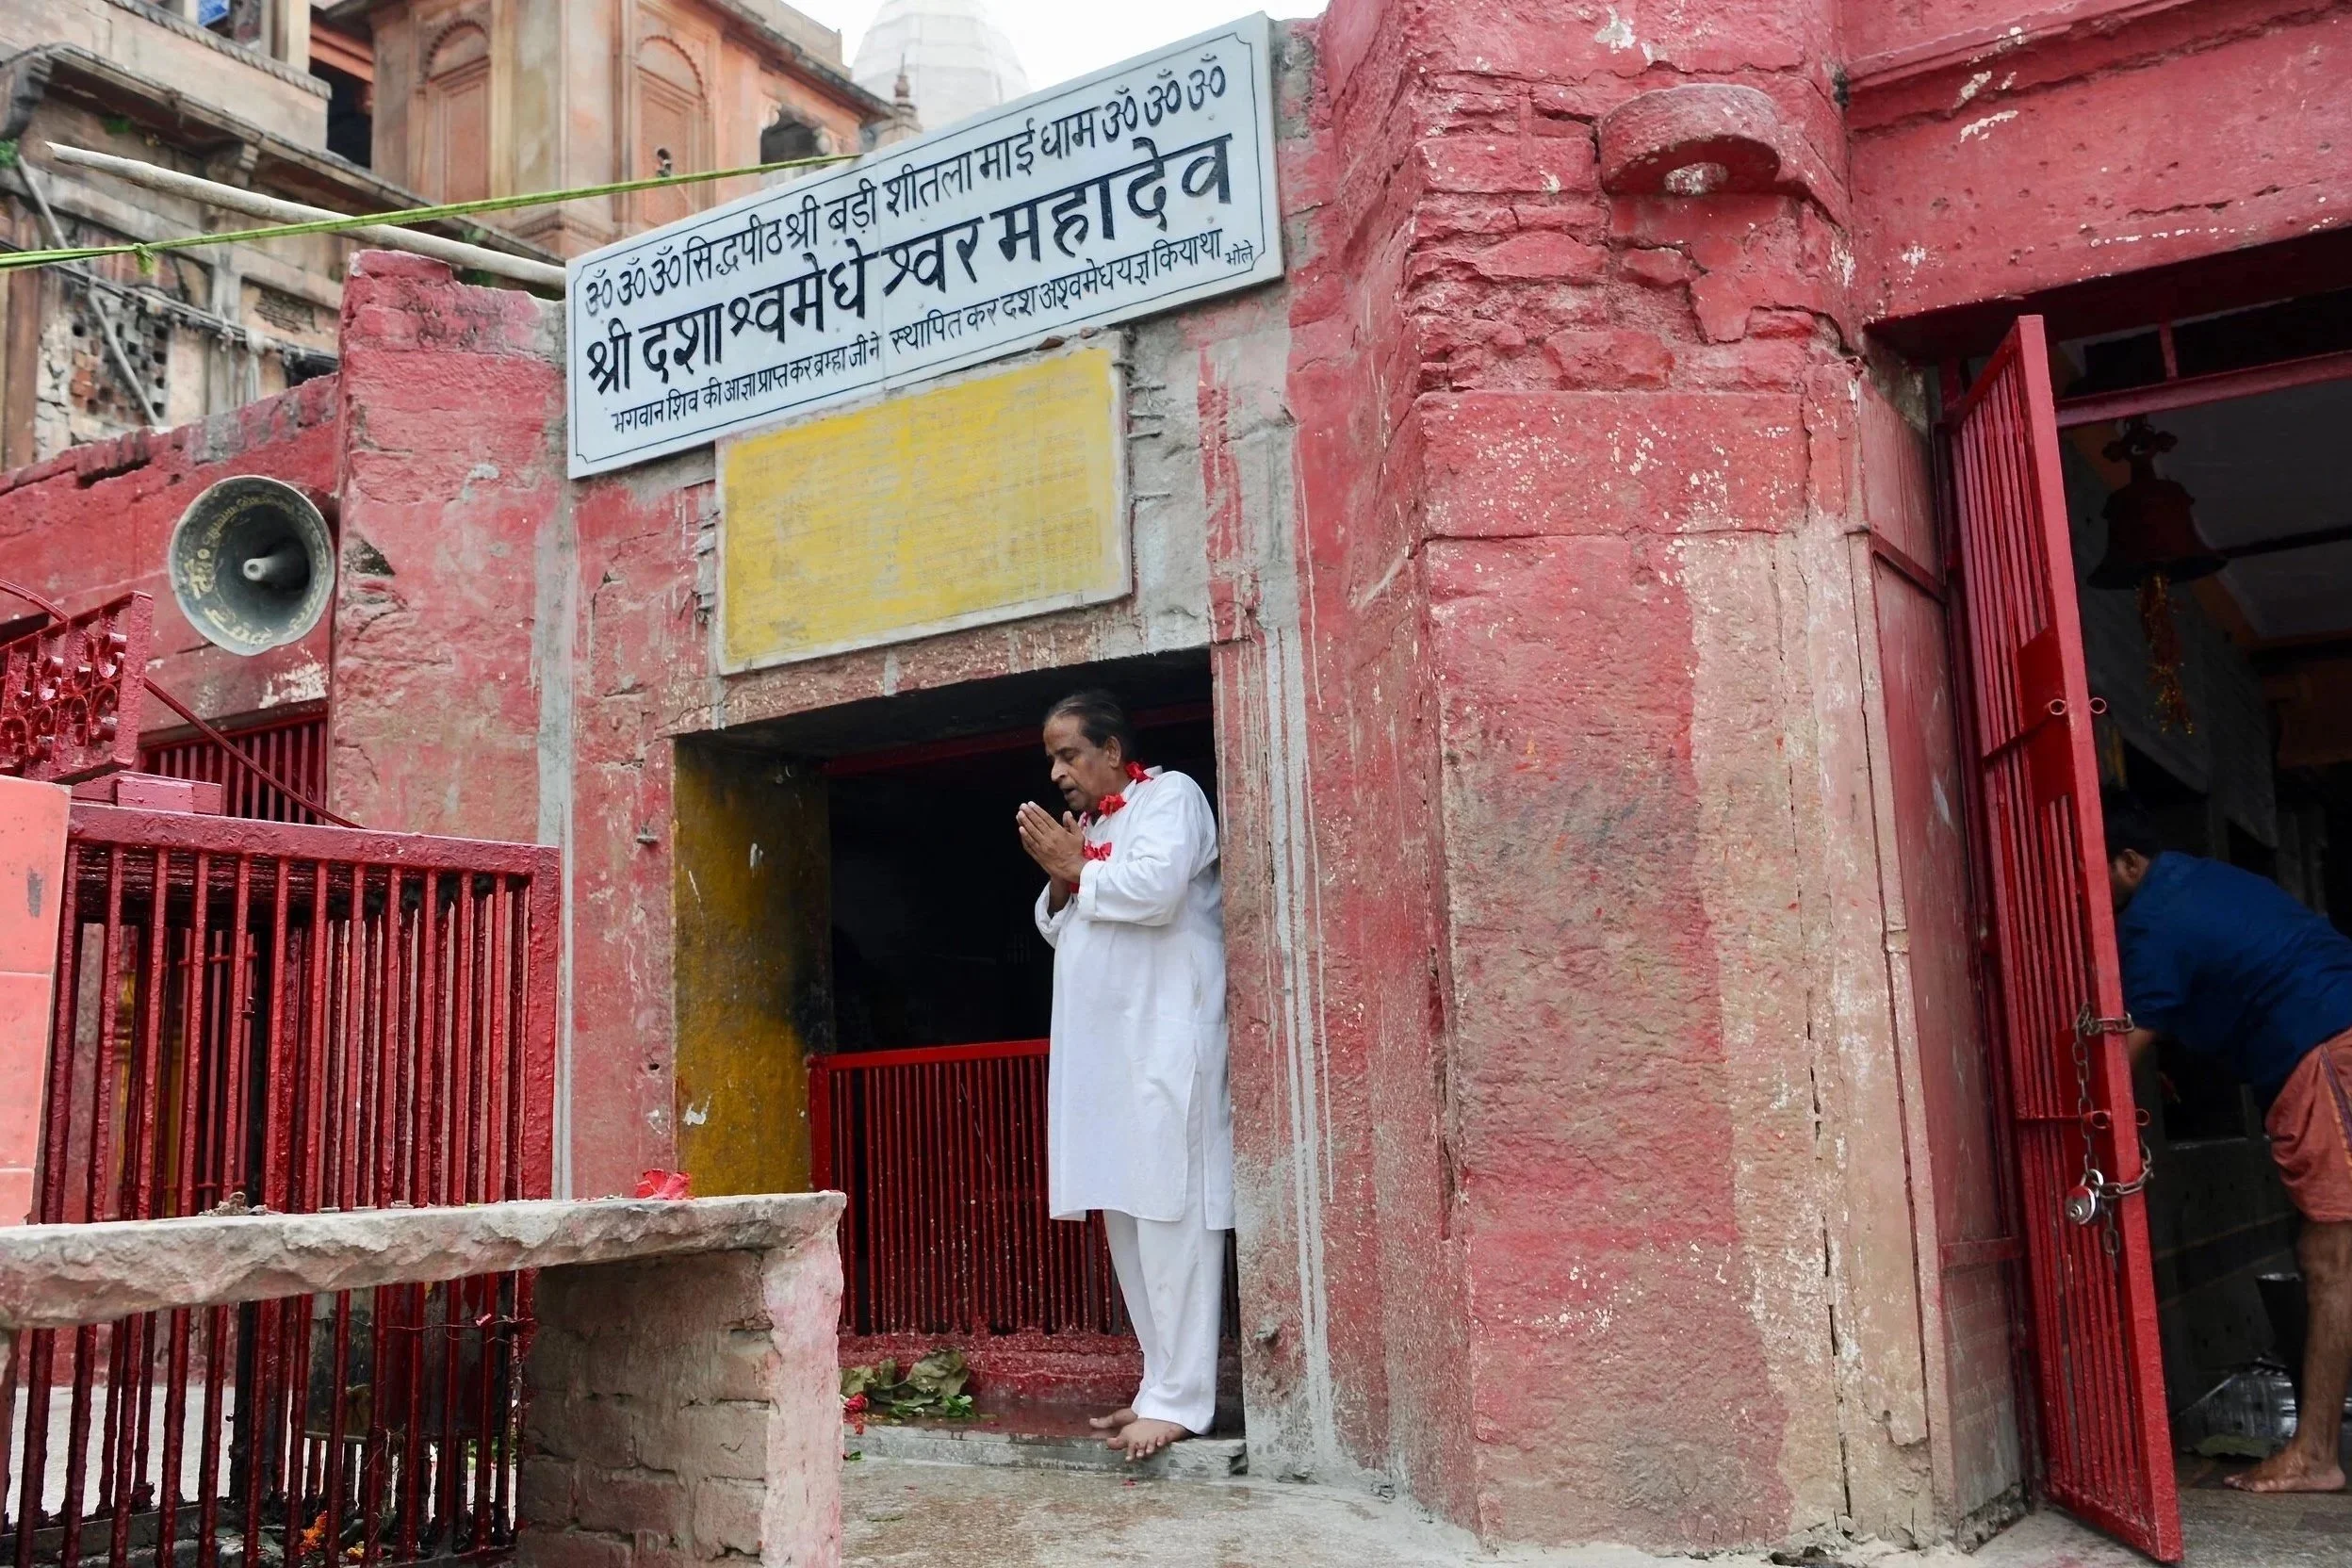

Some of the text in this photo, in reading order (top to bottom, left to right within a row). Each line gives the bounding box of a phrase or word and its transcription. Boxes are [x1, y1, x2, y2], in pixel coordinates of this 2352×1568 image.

[587, 318, 631, 395] श्री
[989, 133, 1233, 265] महादेव
[786, 195, 821, 249] श्री
[825, 178, 878, 234] बड़ी
[882, 163, 972, 218] शीतला
[974, 117, 1036, 181] माई
[1040, 106, 1101, 160] धाम
[611, 400, 663, 434] भगवान
[666, 388, 698, 423] शिव
[701, 376, 722, 409] की
[758, 363, 788, 393] प्राप्त
[789, 355, 813, 383] कर
[889, 308, 962, 355] स्थापित
[963, 298, 999, 331] कर
[1000, 285, 1037, 319] दश
[1116, 250, 1151, 286] यज्ञ
